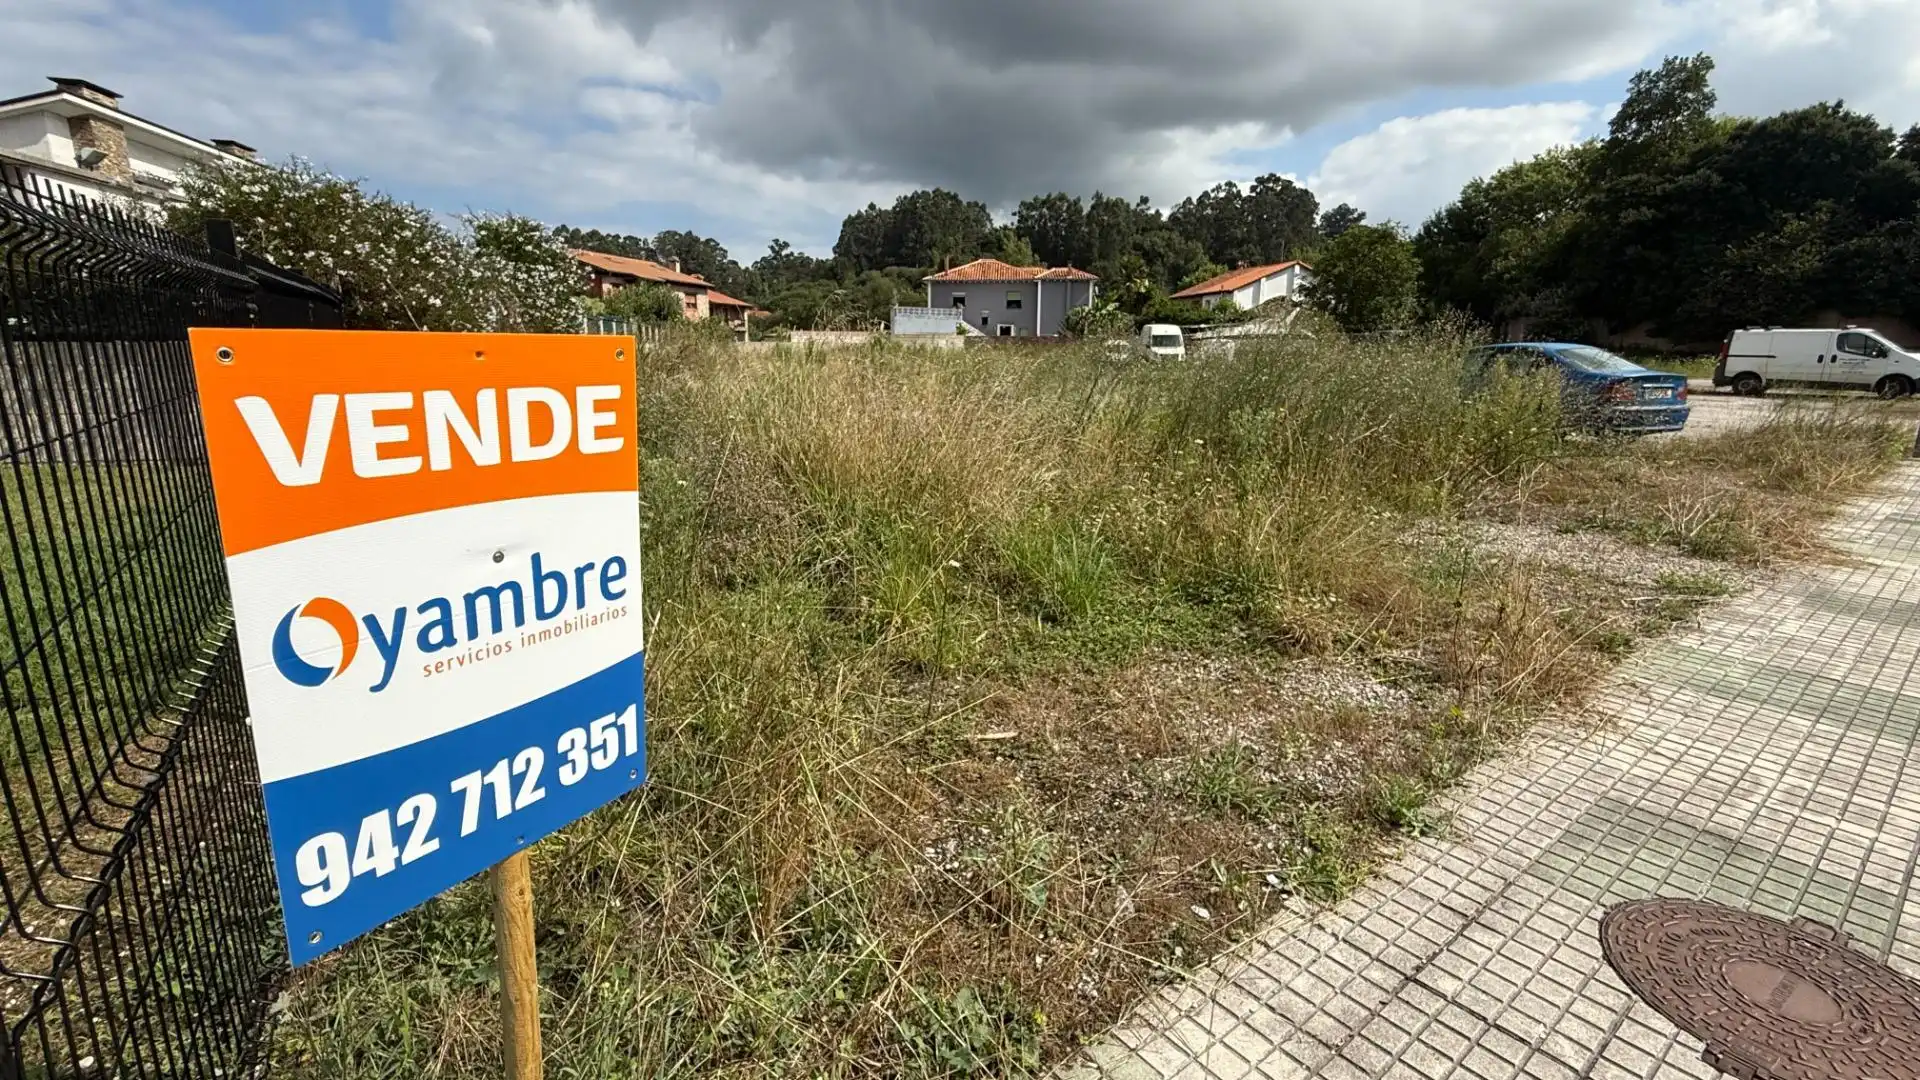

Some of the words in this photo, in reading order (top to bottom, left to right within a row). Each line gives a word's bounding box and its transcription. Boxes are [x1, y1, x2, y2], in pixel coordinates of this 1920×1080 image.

[234, 384, 625, 487] VENDE
[271, 552, 627, 693] Oyambre
[423, 639, 513, 678] servicios
[519, 605, 628, 649] inmobiliarios
[295, 793, 440, 907] 942
[450, 746, 546, 838] 712
[557, 703, 638, 786] 351
